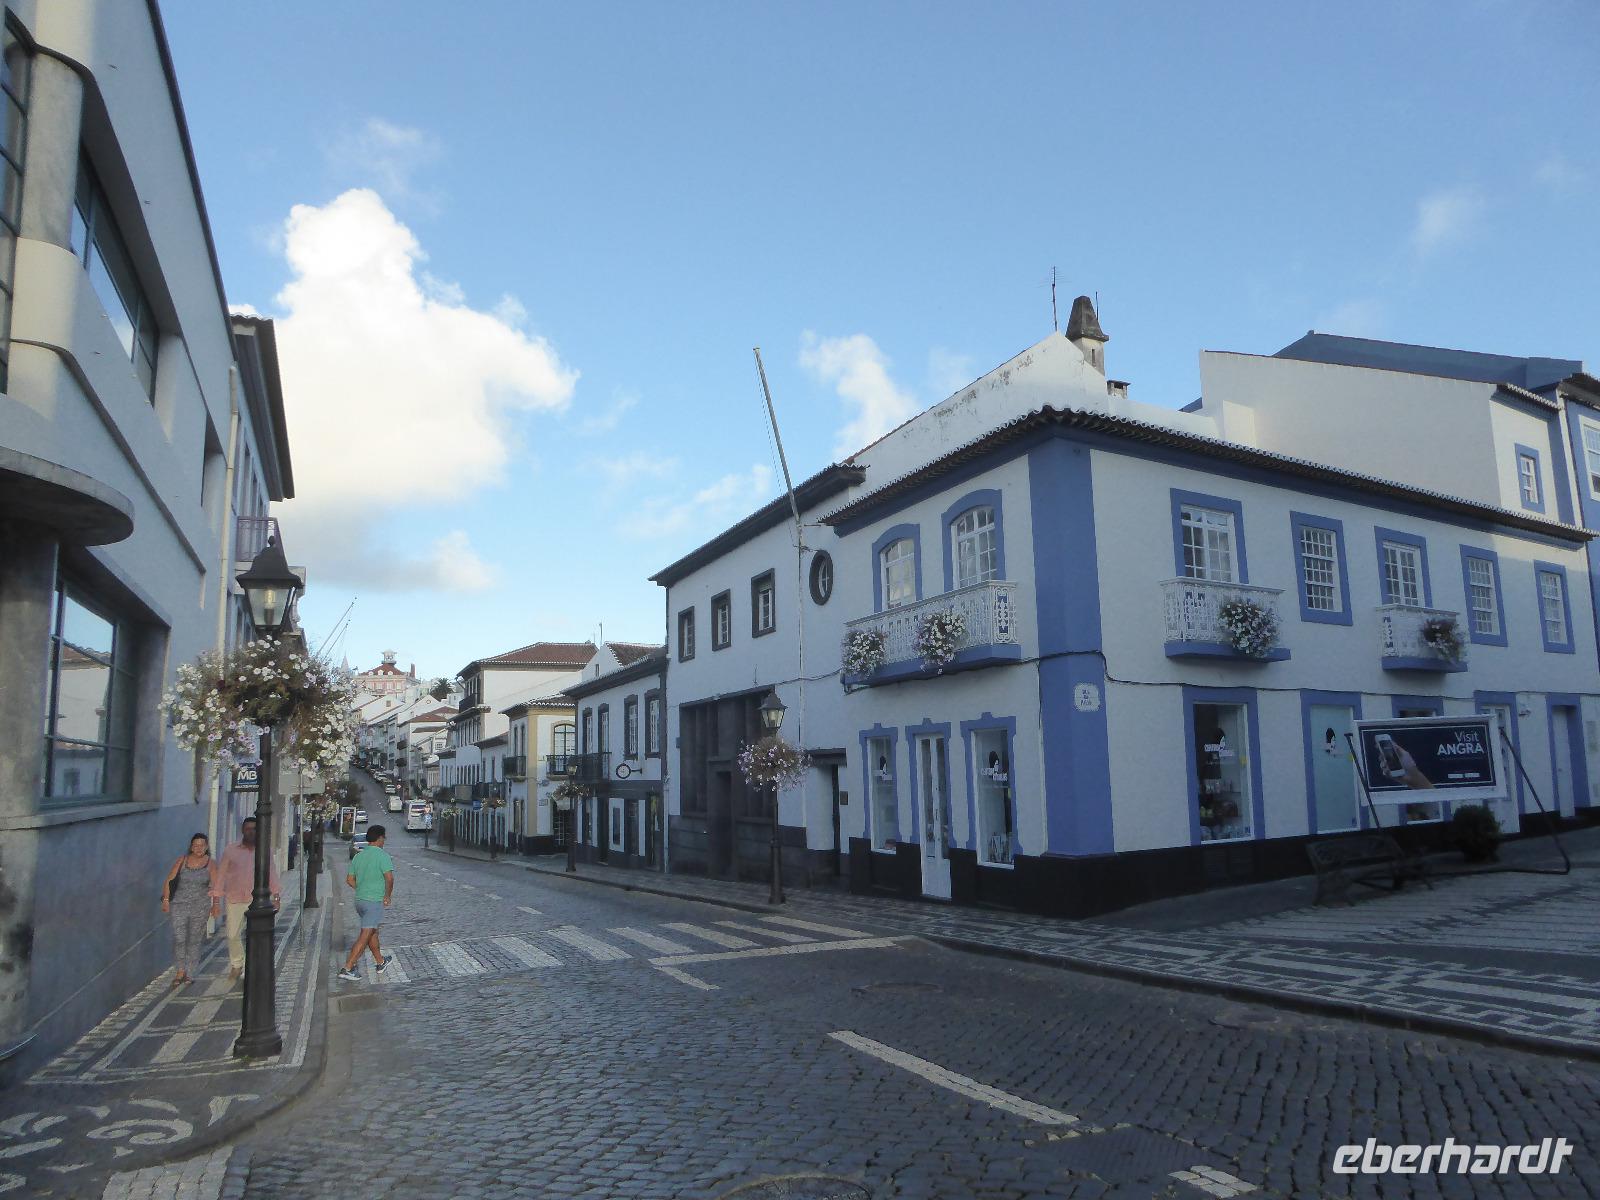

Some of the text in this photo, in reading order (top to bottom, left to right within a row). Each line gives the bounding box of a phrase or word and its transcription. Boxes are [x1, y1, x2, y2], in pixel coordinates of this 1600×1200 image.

[1454, 731, 1480, 742] Visit
[1437, 742, 1485, 755] ANGRA
[237, 770, 258, 781] MB
